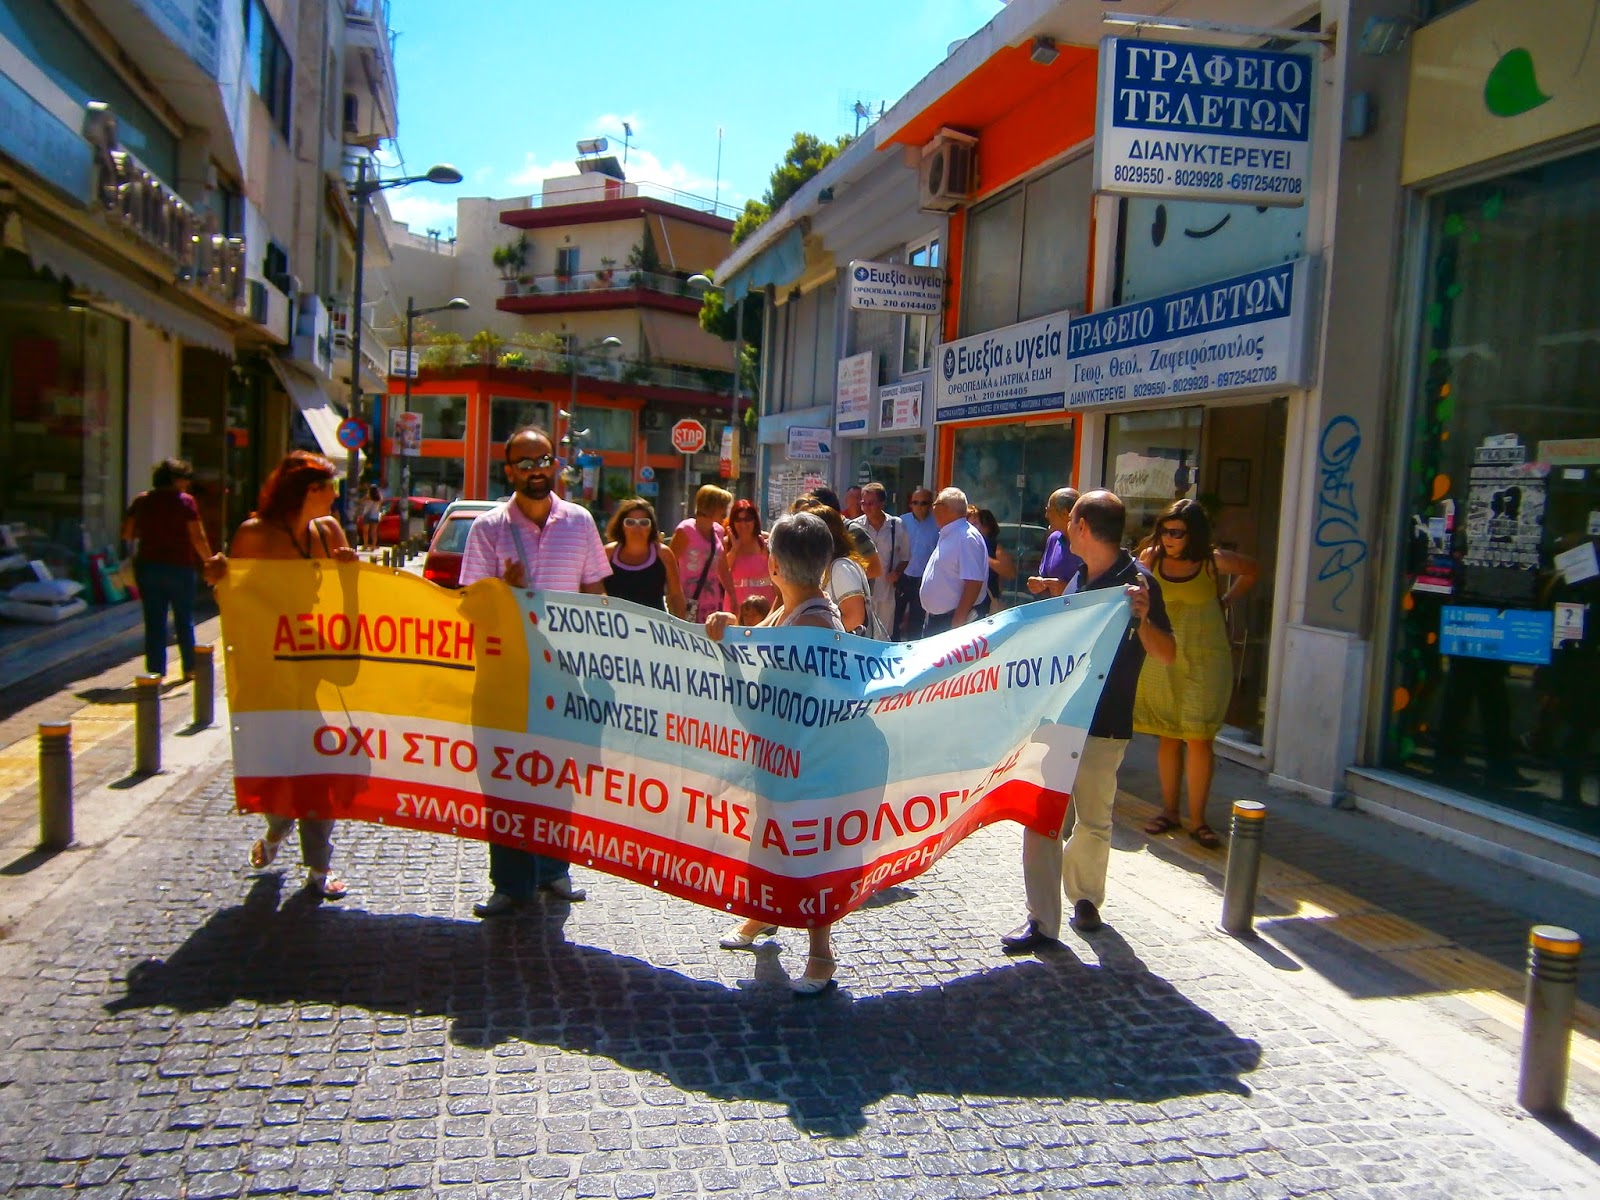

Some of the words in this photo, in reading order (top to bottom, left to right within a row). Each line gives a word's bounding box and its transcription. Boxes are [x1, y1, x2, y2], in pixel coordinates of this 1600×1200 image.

[1125, 47, 1302, 93] ΓΡΑΦΕΙΟ
[1120, 88, 1305, 134] ΤΕΛΕΤΩΝ
[1114, 165, 1164, 183] 8029550
[1175, 169, 1223, 188] 8029928
[1129, 140, 1290, 169] ΔΙΑΝΥΚΤΕΡΕΥΕΙ
[870, 268, 906, 287] Ευεξία
[914, 274, 941, 289] υγεία
[858, 297, 877, 307] Τηλ.
[883, 299, 898, 307] 210
[900, 301, 937, 310] 6144405
[1069, 307, 1154, 352] ΓΡΑΦΕΙΟ
[1165, 272, 1289, 333] ΤΕΛΕΤΩΝ
[958, 339, 1004, 377] Ευεξία
[1006, 349, 1012, 365] &
[1015, 324, 1062, 369] υγεία
[1073, 362, 1104, 385] Γεωρ.
[1109, 352, 1142, 376] Θεολ.
[1149, 333, 1264, 373] Ζαφειρόπουλος
[948, 379, 993, 395] ΟΡΘΟΠΕΔΙΚΑ
[1000, 372, 1030, 386] ΙΑΤΡΙΚΑ
[1032, 367, 1052, 382] ΕΙΔΗ
[982, 392, 994, 400] 210
[996, 387, 1028, 397] 6144405
[1070, 385, 1126, 406] ΔΙΑΝΥΚΤΕΡΕΥΕΙ
[1134, 381, 1166, 398] 8029550
[1173, 375, 1208, 393] 8029928
[1217, 365, 1277, 388] 6972542708
[675, 428, 703, 444] STOP
[273, 613, 475, 661] ΑΞΙΟΛΟΓΗΣΗ
[546, 604, 629, 639] ΣΧΟΛΕΙΟ
[649, 619, 719, 662] ΜΑΓΑΖΙ
[719, 642, 757, 667] ΜΕ
[757, 644, 850, 681] ΠΕΛΑΤΕΣ
[931, 635, 990, 668] ΝΕΙΣ
[557, 649, 645, 686] ΑΜΑΘΕΙΑ
[650, 661, 681, 693] ΚΑΙ
[686, 667, 872, 728] ΚΑΤΗΓΟΡΙΟΠΟΙΗΣΗ
[874, 687, 917, 715] ΤΩΝ
[918, 664, 1001, 705] ΠΑΙΔΙΩΝ
[1006, 656, 1042, 688] ΤΟΥ
[564, 691, 658, 737] ΑΠΟΛΥΣΕΙΣ
[665, 712, 801, 779] ΕΚΠΑΙΔΕΥΤΙΚΩΝ
[313, 725, 387, 760] ΟΧΙ
[402, 732, 478, 773] ΣΤΟ
[491, 746, 669, 814] ΣΦΑΓΕΙΟ
[682, 787, 751, 841] ΤΗΣ
[396, 792, 525, 838] ΣΥΛΛΟΓΟΣ
[533, 816, 725, 892] ΕΚΠΑΙΔΕΥΤΙΚΩΝ
[732, 875, 782, 914] Π.Ε.
